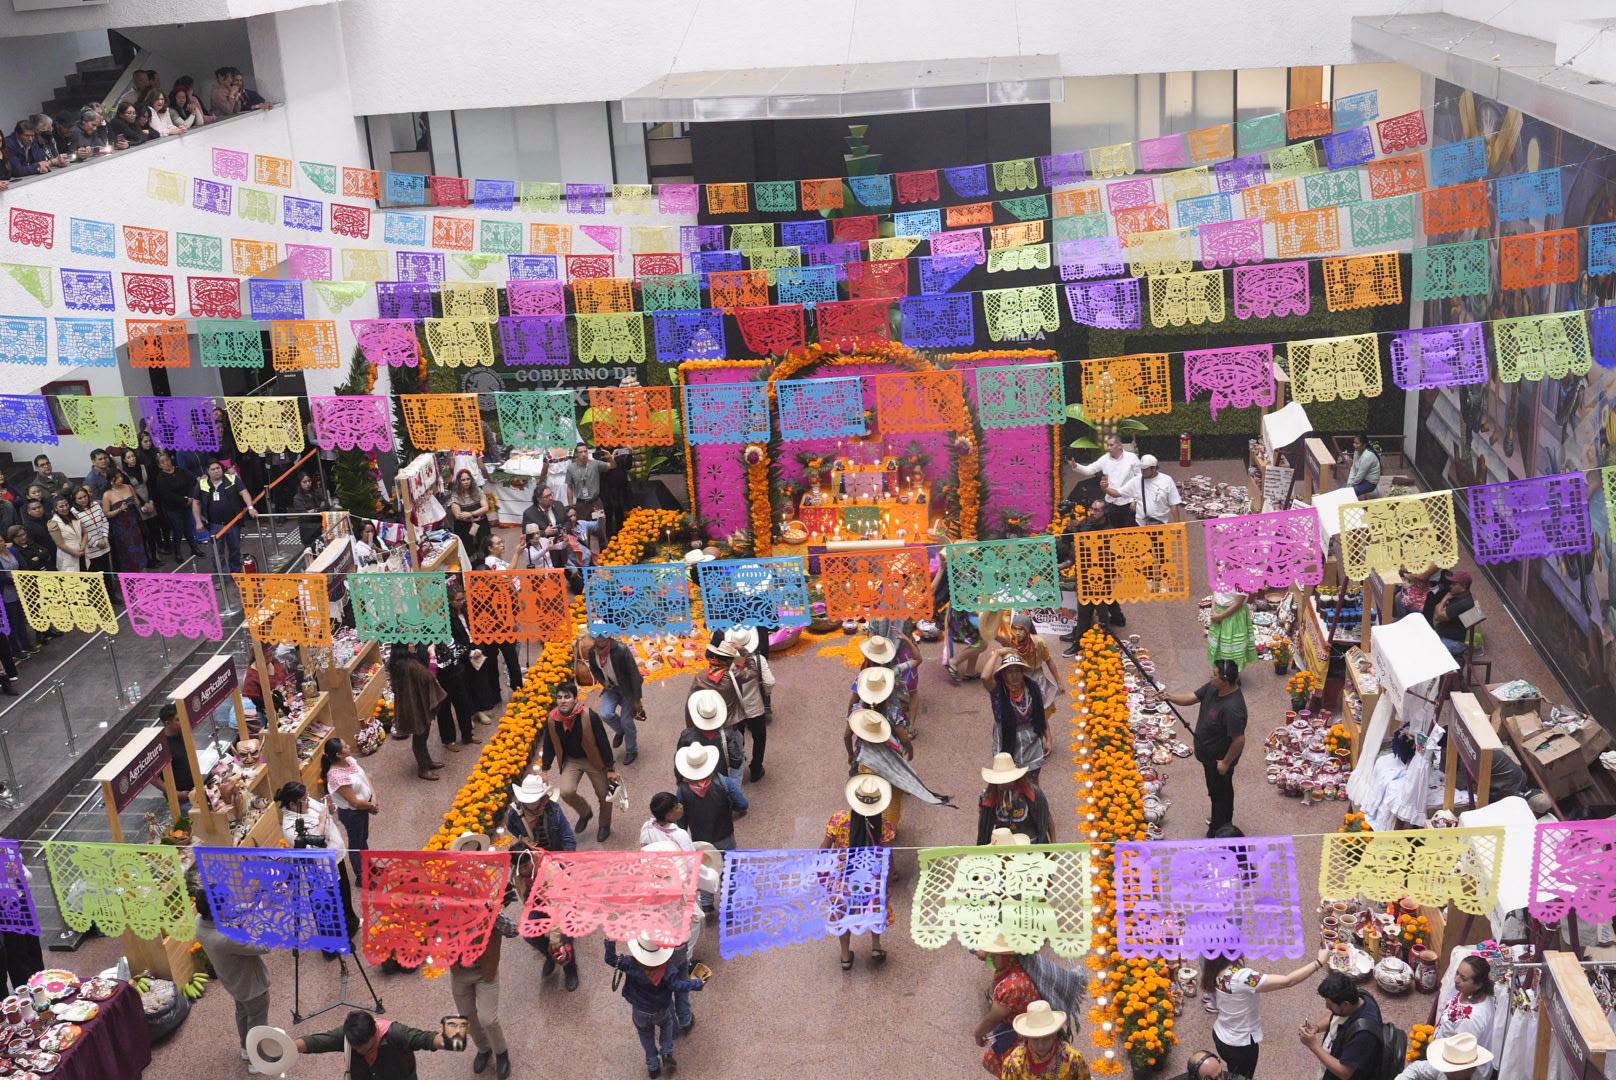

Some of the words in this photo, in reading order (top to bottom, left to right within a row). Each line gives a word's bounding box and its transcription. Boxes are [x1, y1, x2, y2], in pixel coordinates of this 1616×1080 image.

[515, 367, 609, 382] GOBIERNO
[613, 366, 637, 380] DE
[200, 669, 232, 702] Agricultura
[128, 743, 163, 782] Agricultura
